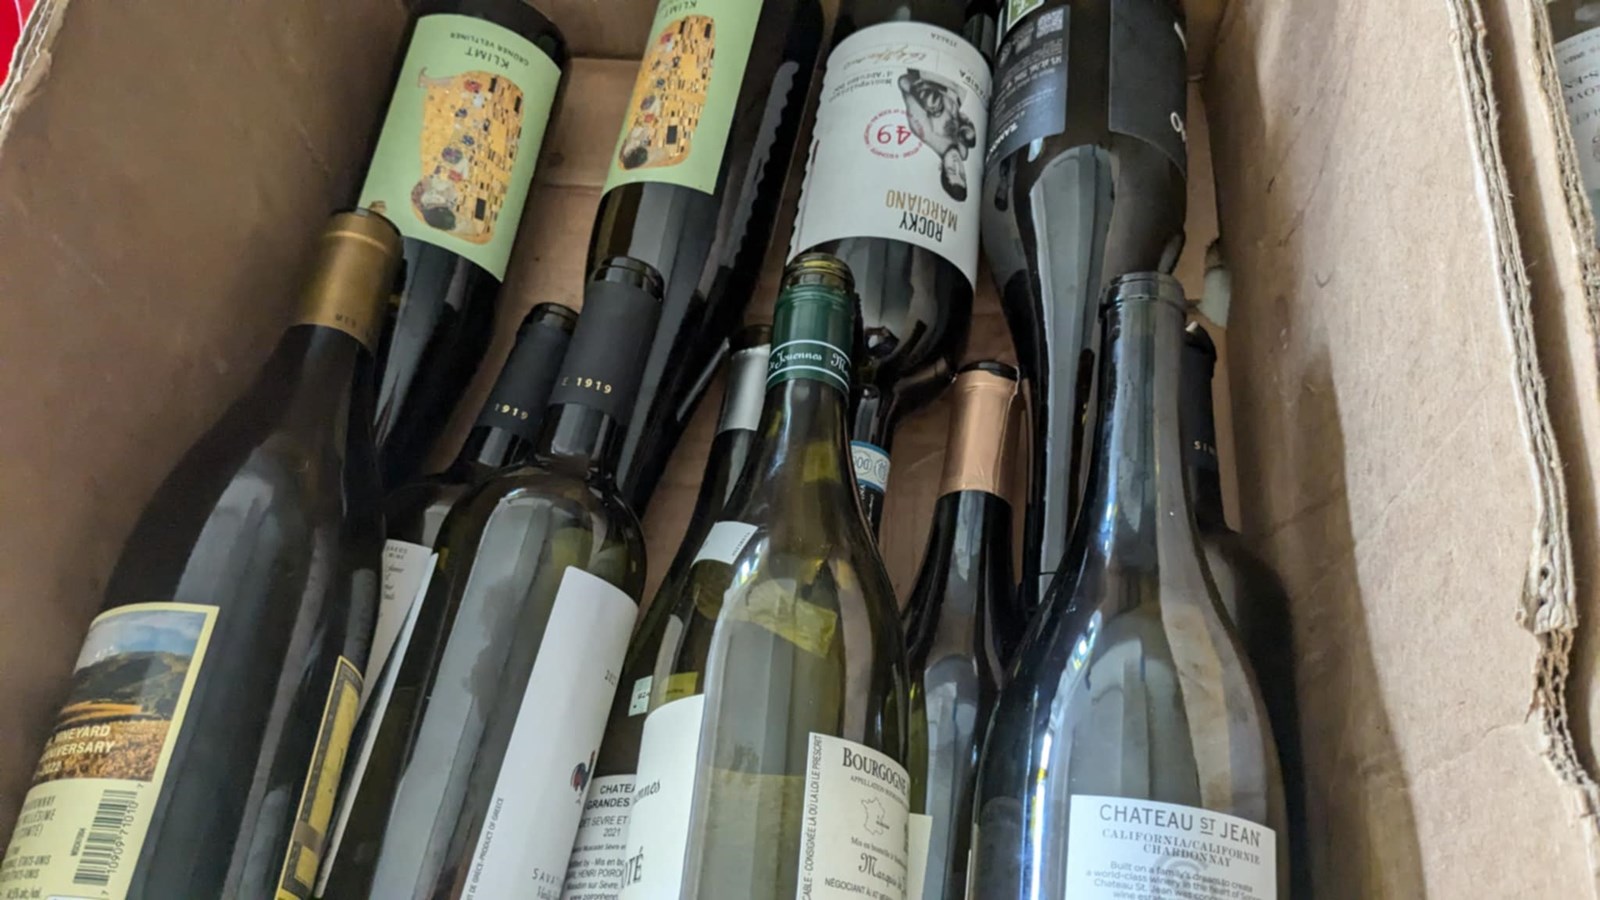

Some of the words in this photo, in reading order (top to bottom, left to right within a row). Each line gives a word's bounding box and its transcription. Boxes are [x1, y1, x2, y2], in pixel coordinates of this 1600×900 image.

[464, 46, 510, 69] KLIMT
[876, 123, 912, 146] 49
[885, 189, 958, 232] MARCIANO
[899, 211, 944, 243] ROCKY
[576, 376, 613, 395] 1919
[494, 402, 529, 421] 1919
[812, 734, 823, 770] PRESCRIT
[811, 770, 821, 780] LE
[842, 747, 907, 797] BOURGOGNE
[810, 781, 820, 793] LOI
[586, 797, 630, 811] GRANDES
[1100, 804, 1193, 831] CHATEAU
[1219, 822, 1261, 848] JEAN
[1102, 828, 1261, 865] CALIFORNIA/CALIFORNIE
[1143, 844, 1232, 868] CHARDONNAY
[1094, 870, 1148, 882] world-class
[1110, 861, 1132, 871] Built
[1133, 864, 1147, 873] on
[1094, 878, 1133, 890] Chateau
